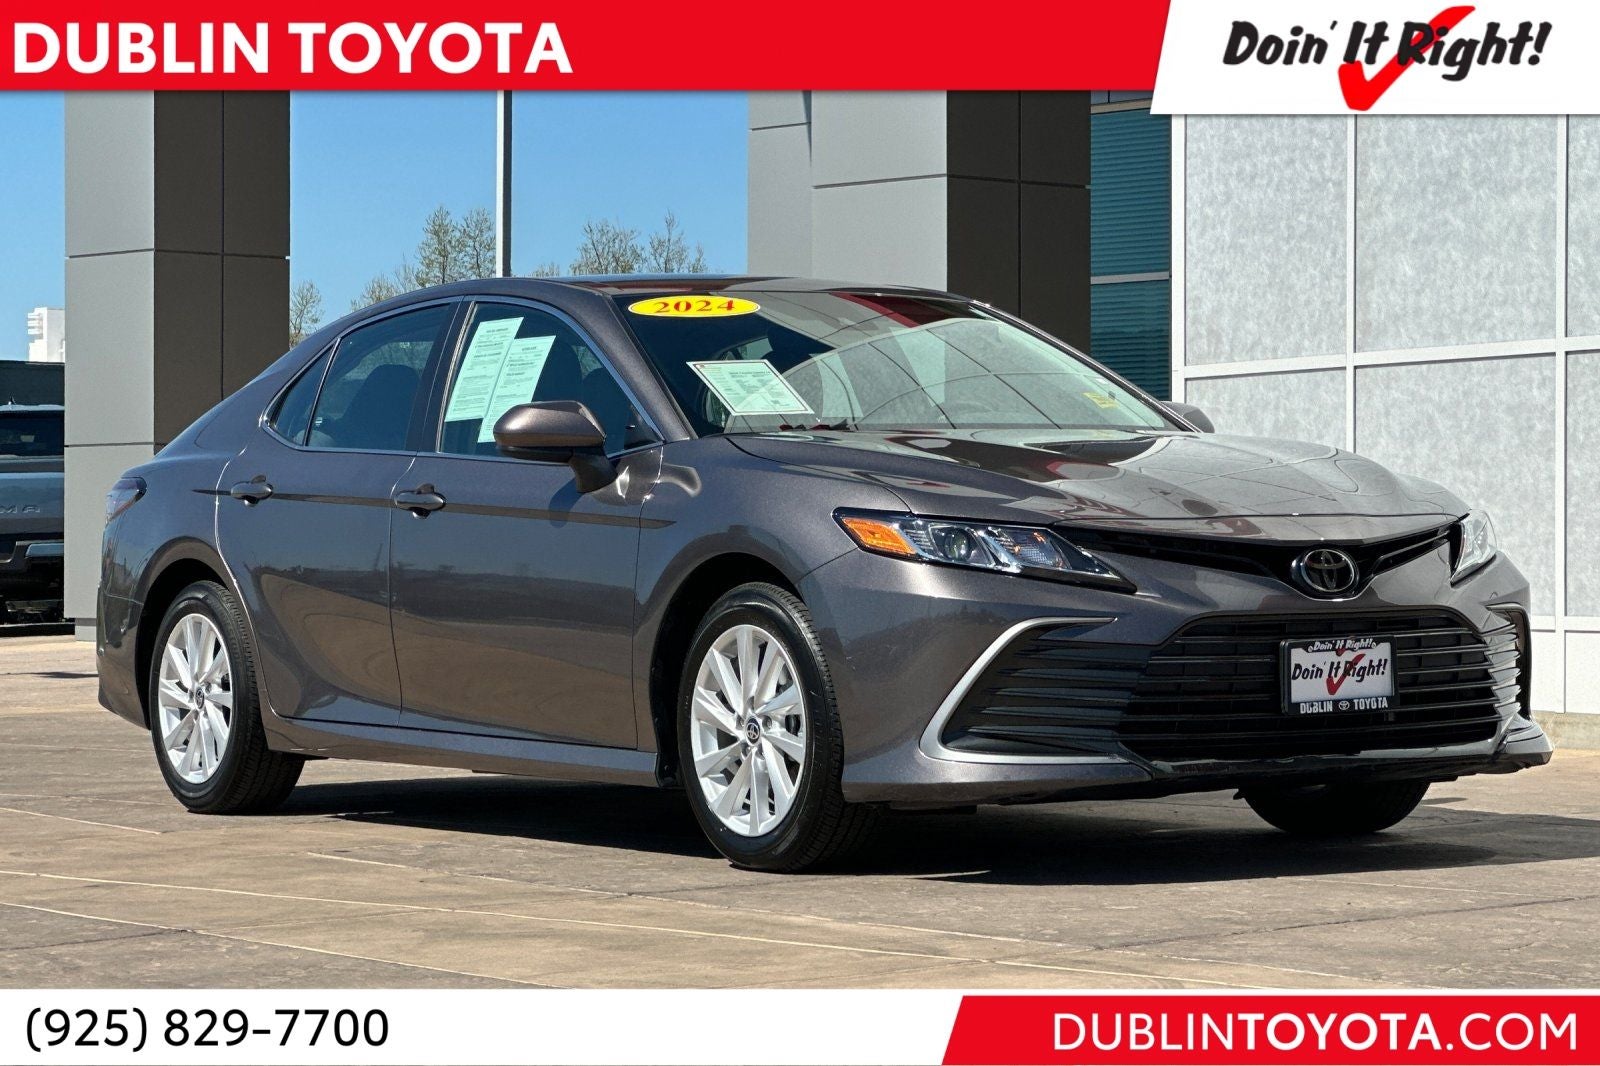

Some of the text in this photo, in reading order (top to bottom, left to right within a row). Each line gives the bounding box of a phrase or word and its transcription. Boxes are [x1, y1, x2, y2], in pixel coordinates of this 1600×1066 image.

[654, 299, 735, 313] 2024
[1313, 638, 1374, 651] Doin' It Right!
[1291, 658, 1388, 683] Doin' It Right!
[1300, 697, 1388, 714] DUBLIN TOYOTA
